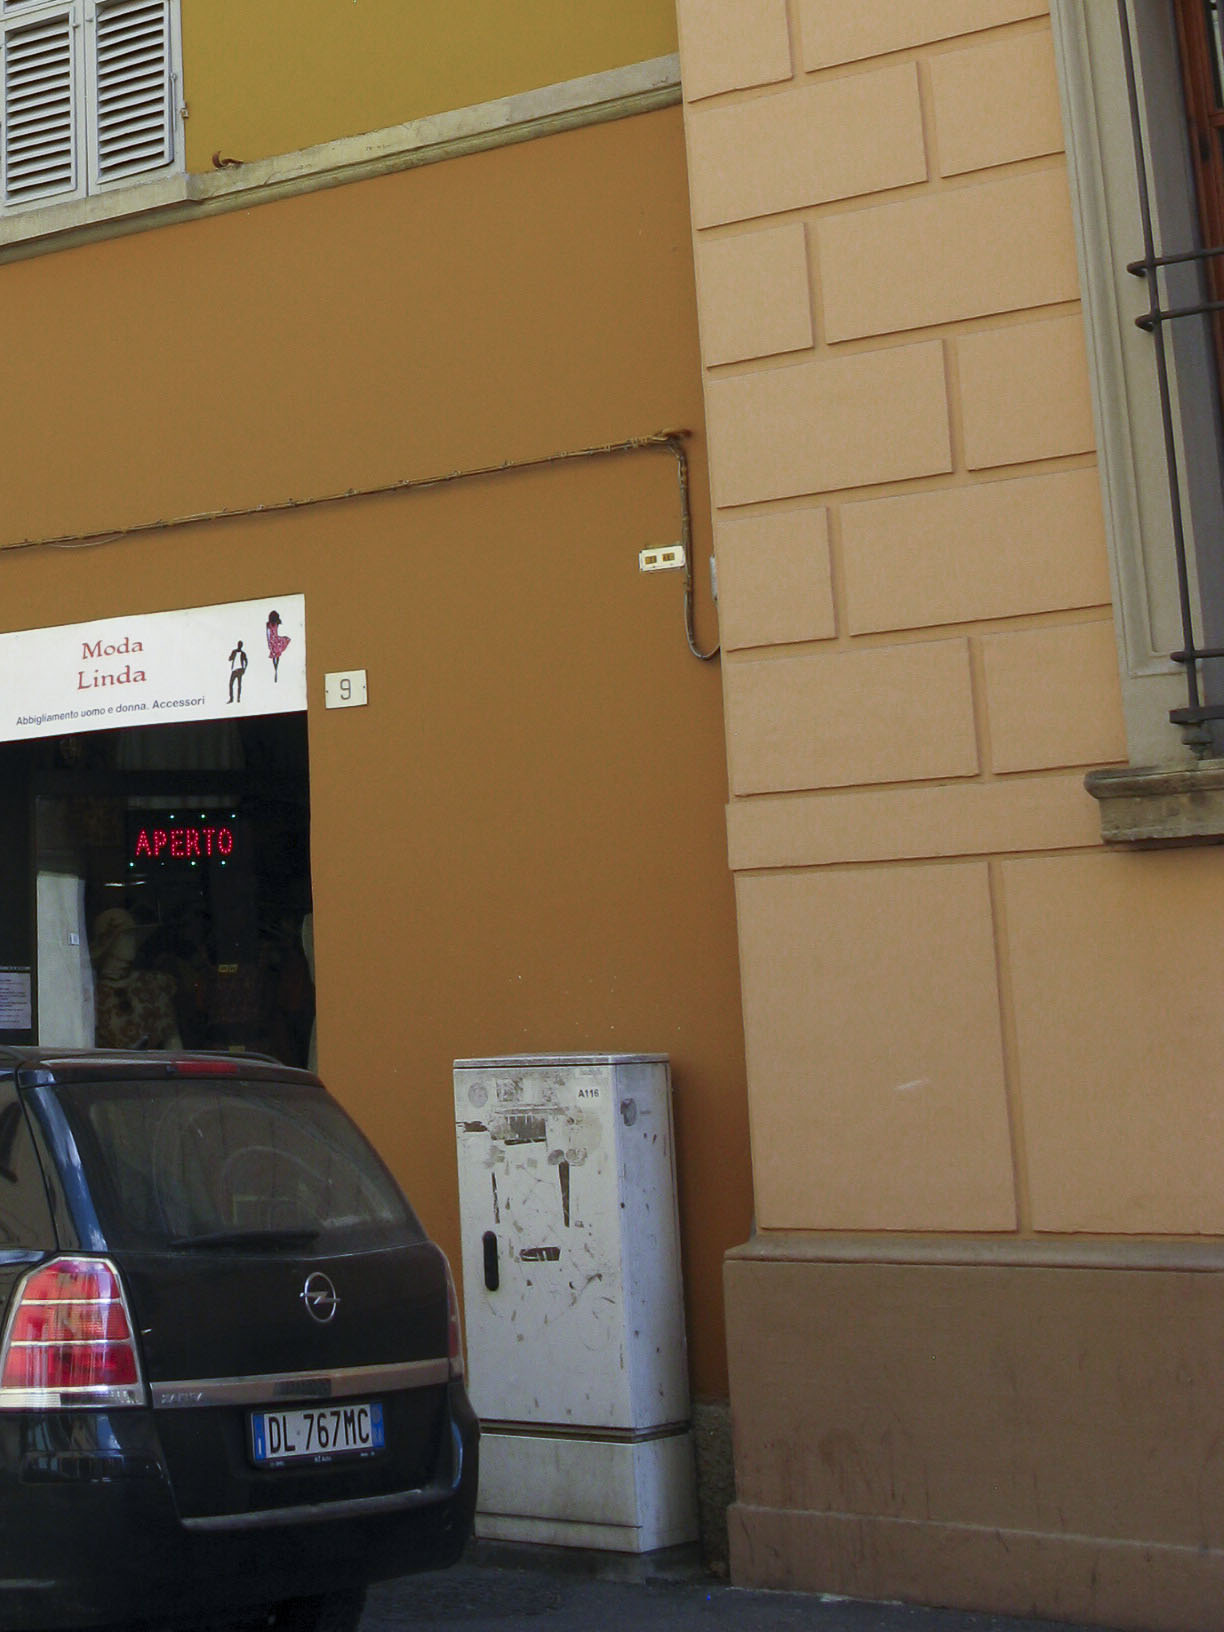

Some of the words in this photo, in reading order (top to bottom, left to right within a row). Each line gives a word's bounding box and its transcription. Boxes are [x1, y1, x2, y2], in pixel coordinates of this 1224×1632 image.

[81, 636, 145, 661] Moda
[76, 665, 147, 691] Linda
[340, 678, 352, 700] 9
[15, 710, 79, 727] Abbigliamento
[80, 707, 106, 719] uomo
[107, 707, 114, 715] e
[152, 695, 206, 710] Accessori
[134, 827, 235, 857] APERTO
[268, 1415, 296, 1454] DL
[303, 1408, 370, 1451] 767MC
